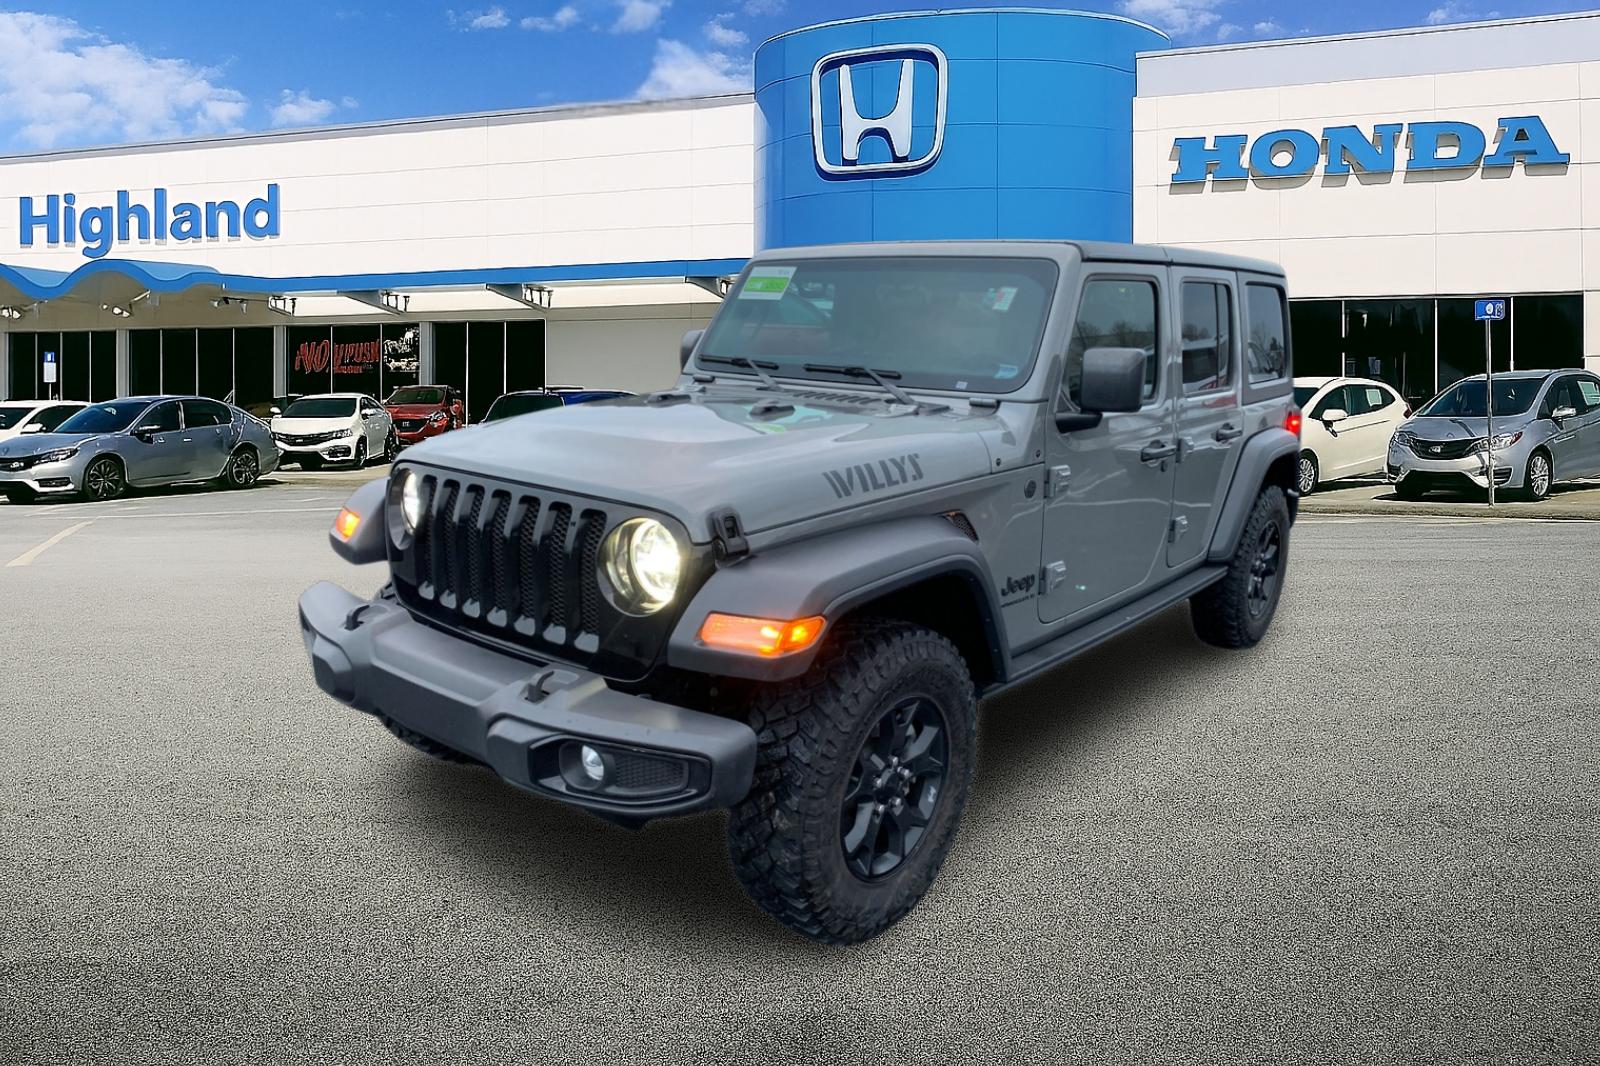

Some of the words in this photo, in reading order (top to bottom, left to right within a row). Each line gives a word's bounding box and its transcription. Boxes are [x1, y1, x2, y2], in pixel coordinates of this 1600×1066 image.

[1170, 115, 1571, 184] HONDA
[19, 183, 281, 259] Highland
[821, 453, 924, 499] WILLYS
[1001, 574, 1036, 597] Jeep
